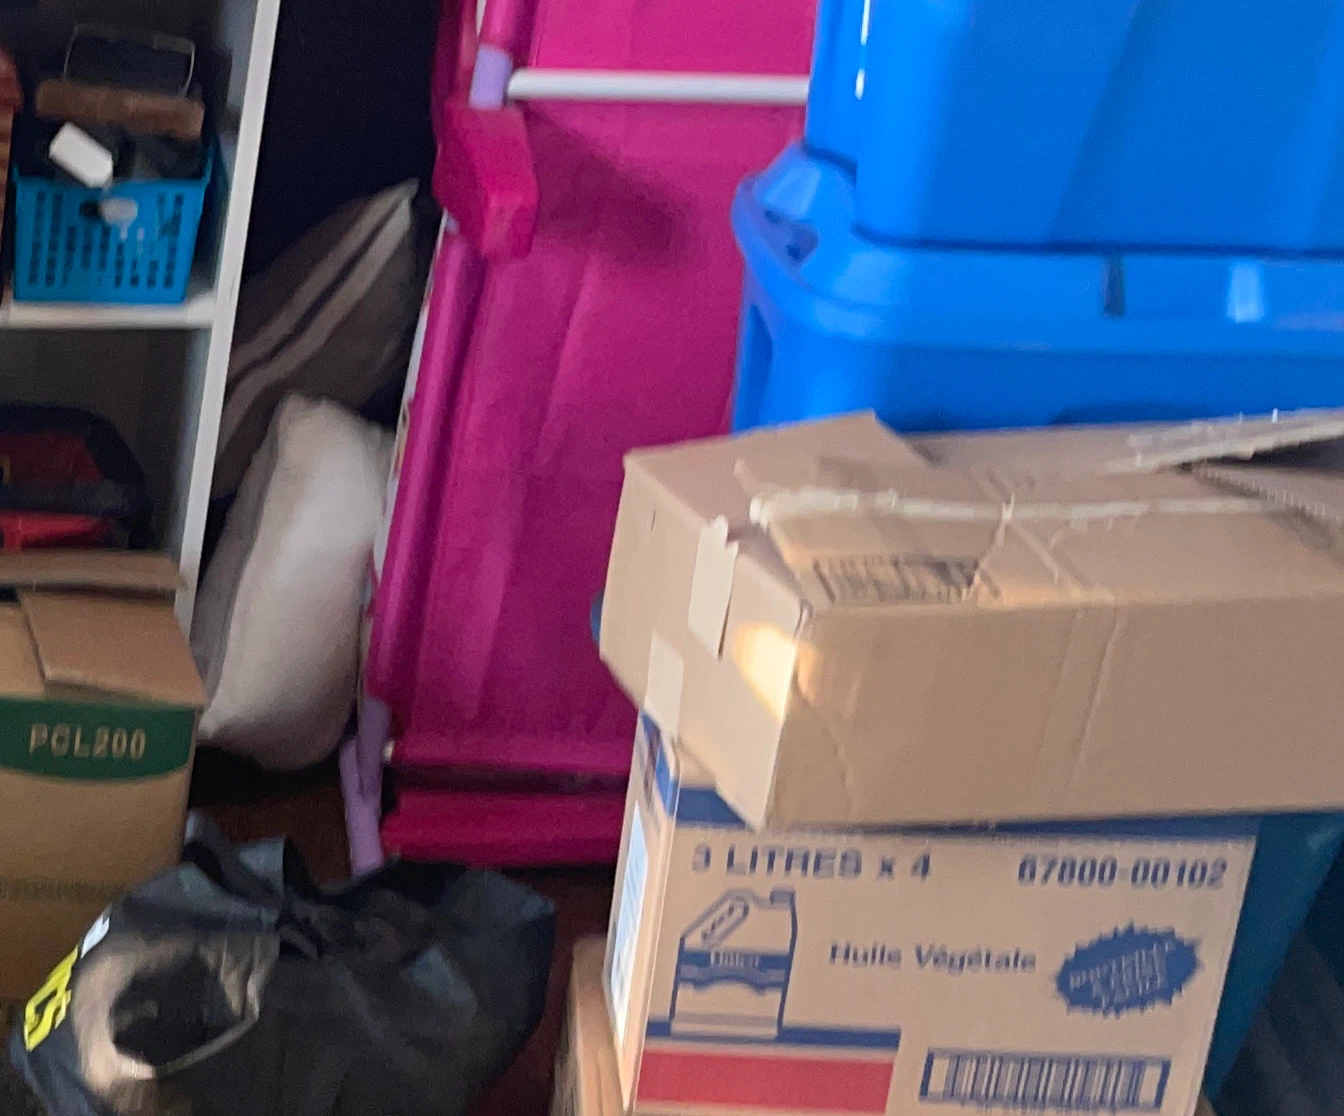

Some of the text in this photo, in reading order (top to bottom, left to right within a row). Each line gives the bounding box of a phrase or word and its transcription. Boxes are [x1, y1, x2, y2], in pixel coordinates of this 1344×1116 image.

[29, 723, 146, 760] PCL200
[726, 843, 862, 880] LITRES
[911, 850, 931, 882] 4
[829, 939, 902, 970] Huile
[915, 942, 1036, 977] Végétale
